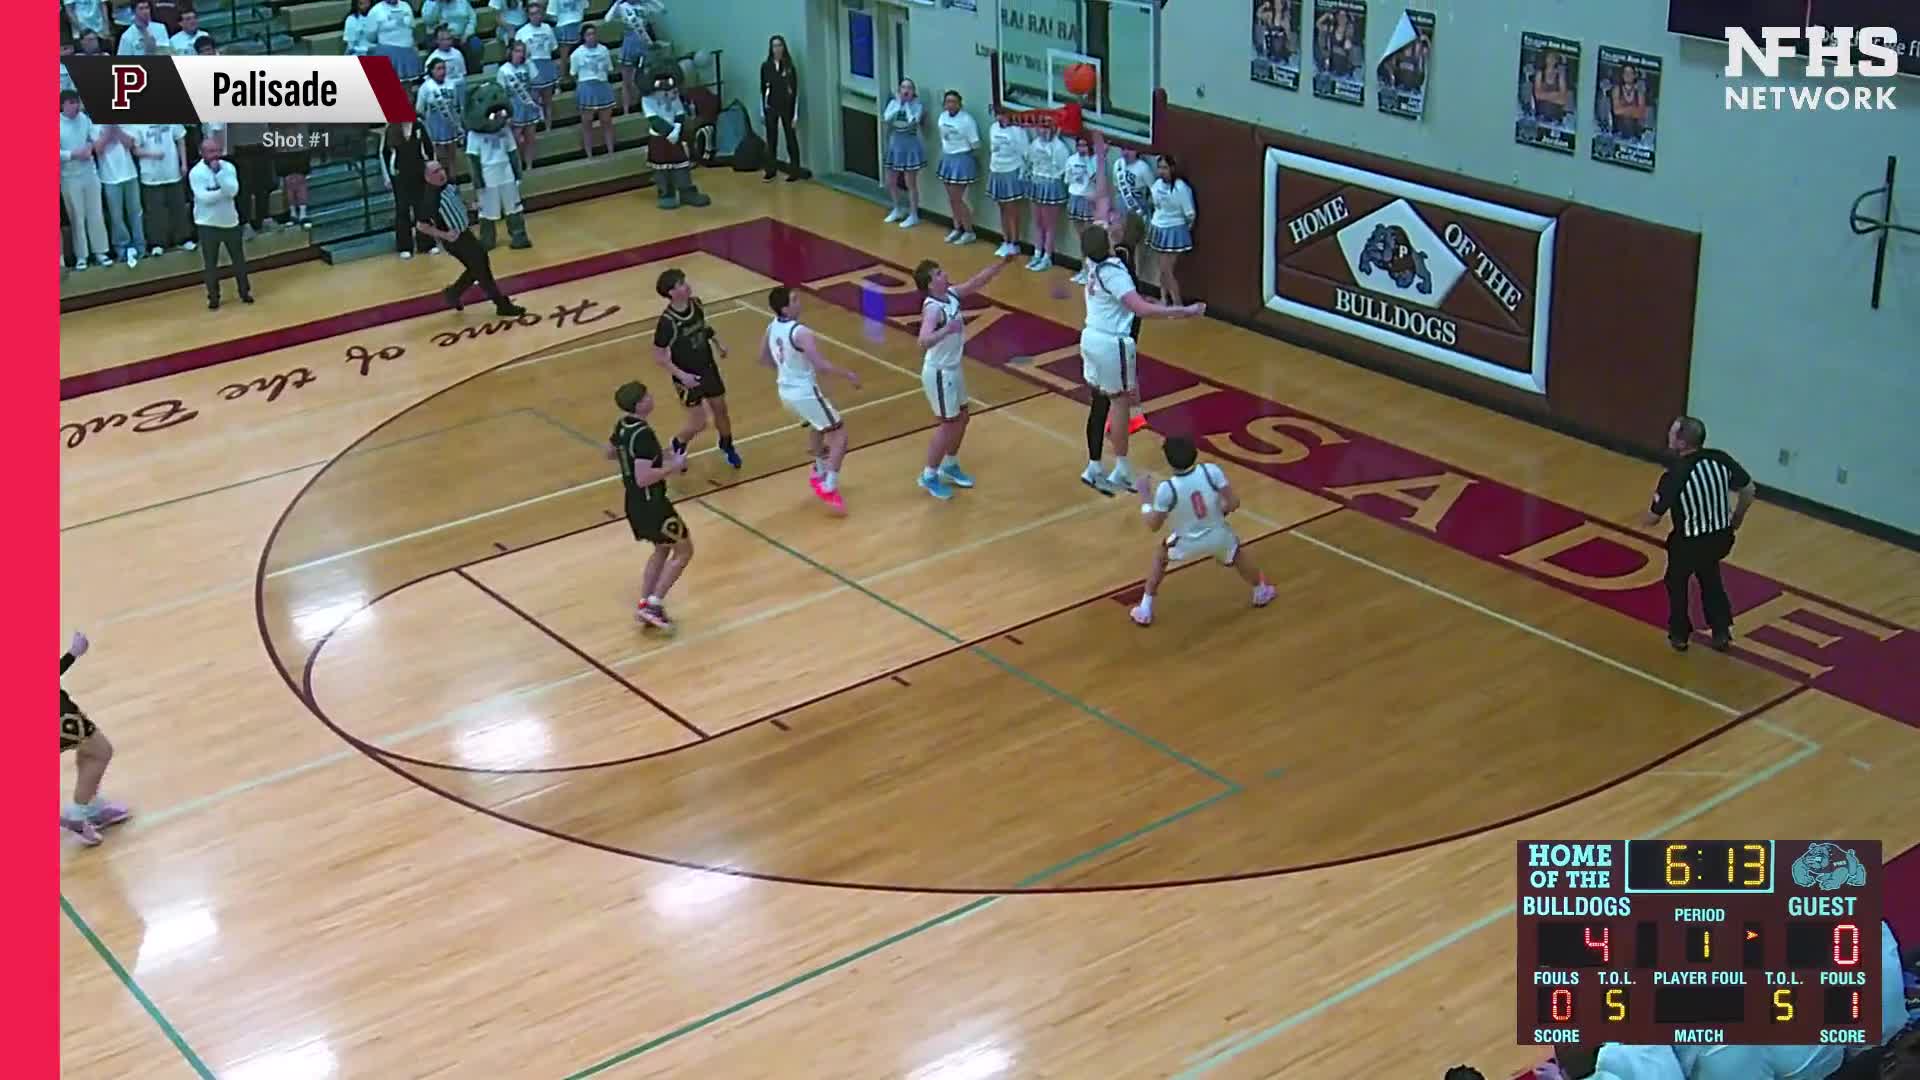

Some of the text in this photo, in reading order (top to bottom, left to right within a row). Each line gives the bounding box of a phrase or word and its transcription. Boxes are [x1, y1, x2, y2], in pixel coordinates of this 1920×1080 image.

[1288, 196, 1349, 244] HOME
[1444, 224, 1523, 311] OF THE
[1335, 288, 1457, 346] BULLDOGS
[217, 366, 316, 402] the
